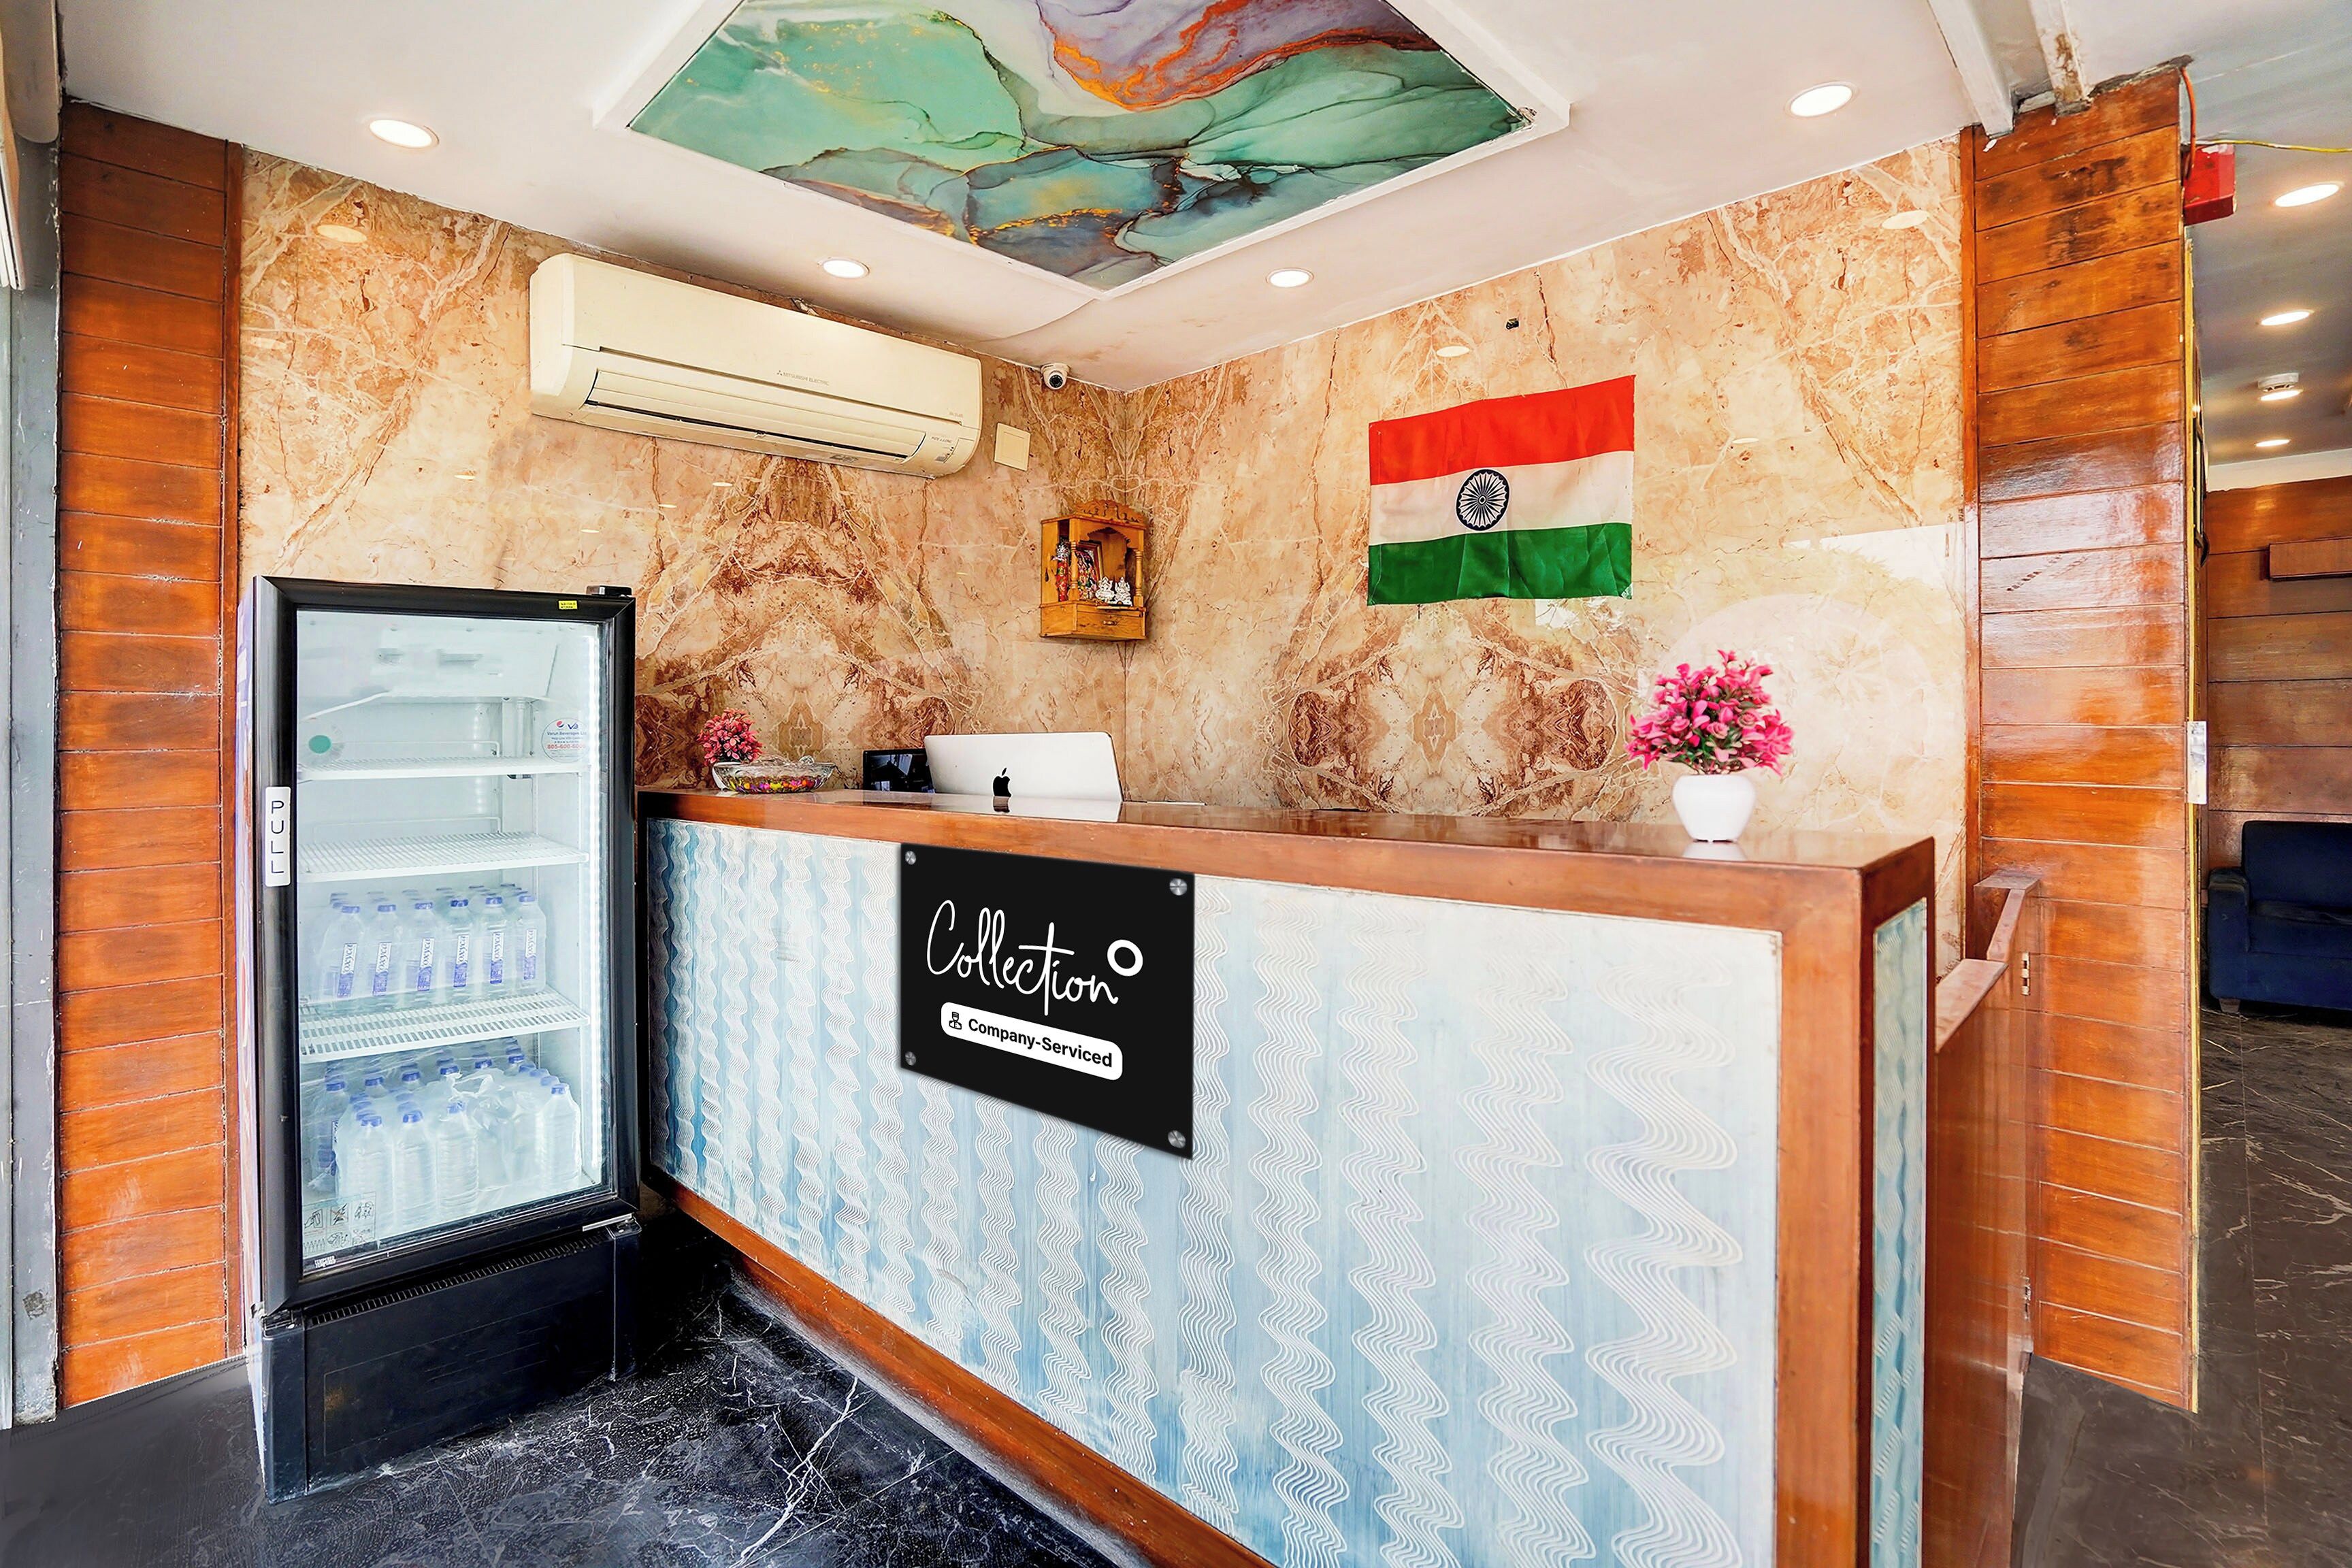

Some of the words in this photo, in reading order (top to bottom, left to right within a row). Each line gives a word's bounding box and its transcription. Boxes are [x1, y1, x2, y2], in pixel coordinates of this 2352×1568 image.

[271, 800, 284, 874] PULL
[926, 900, 1120, 1016] Collection
[968, 1018, 1113, 1068] Company-Serviced
